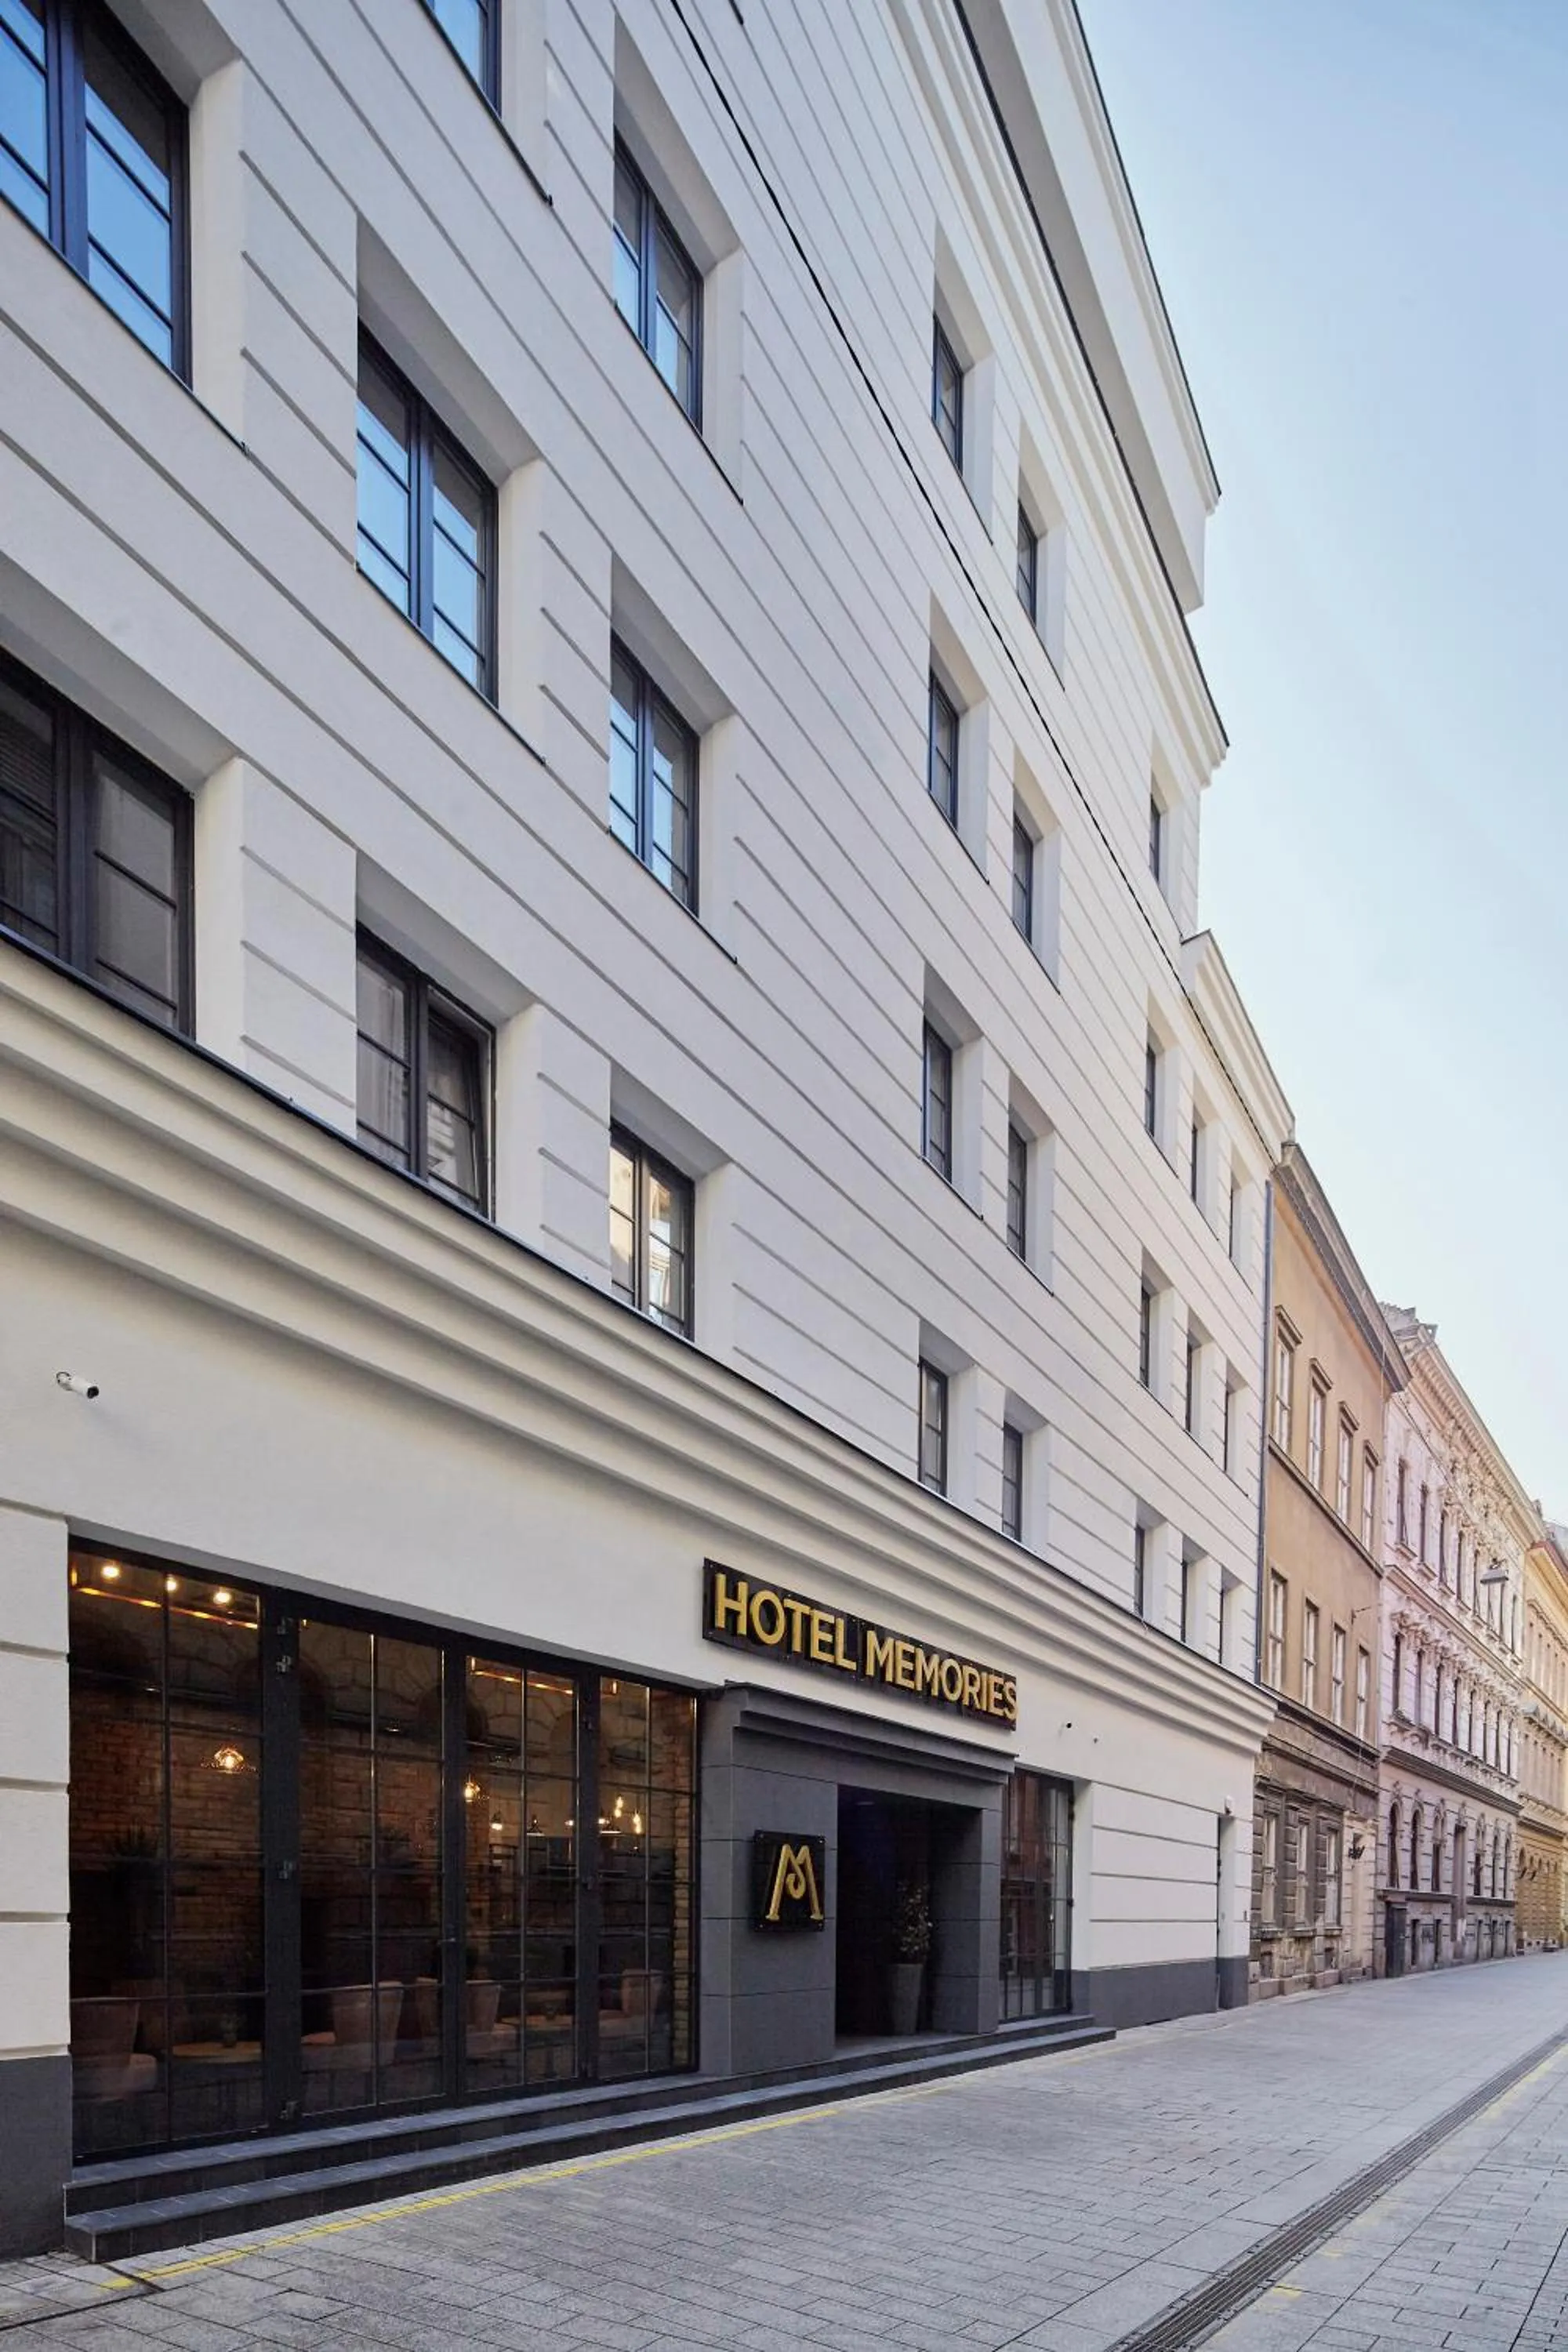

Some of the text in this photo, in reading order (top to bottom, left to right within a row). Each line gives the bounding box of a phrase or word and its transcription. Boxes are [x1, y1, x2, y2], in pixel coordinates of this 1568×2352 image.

[714, 1573, 1018, 1721] HOTEL MEMORIES
[765, 1843, 824, 1921] M
